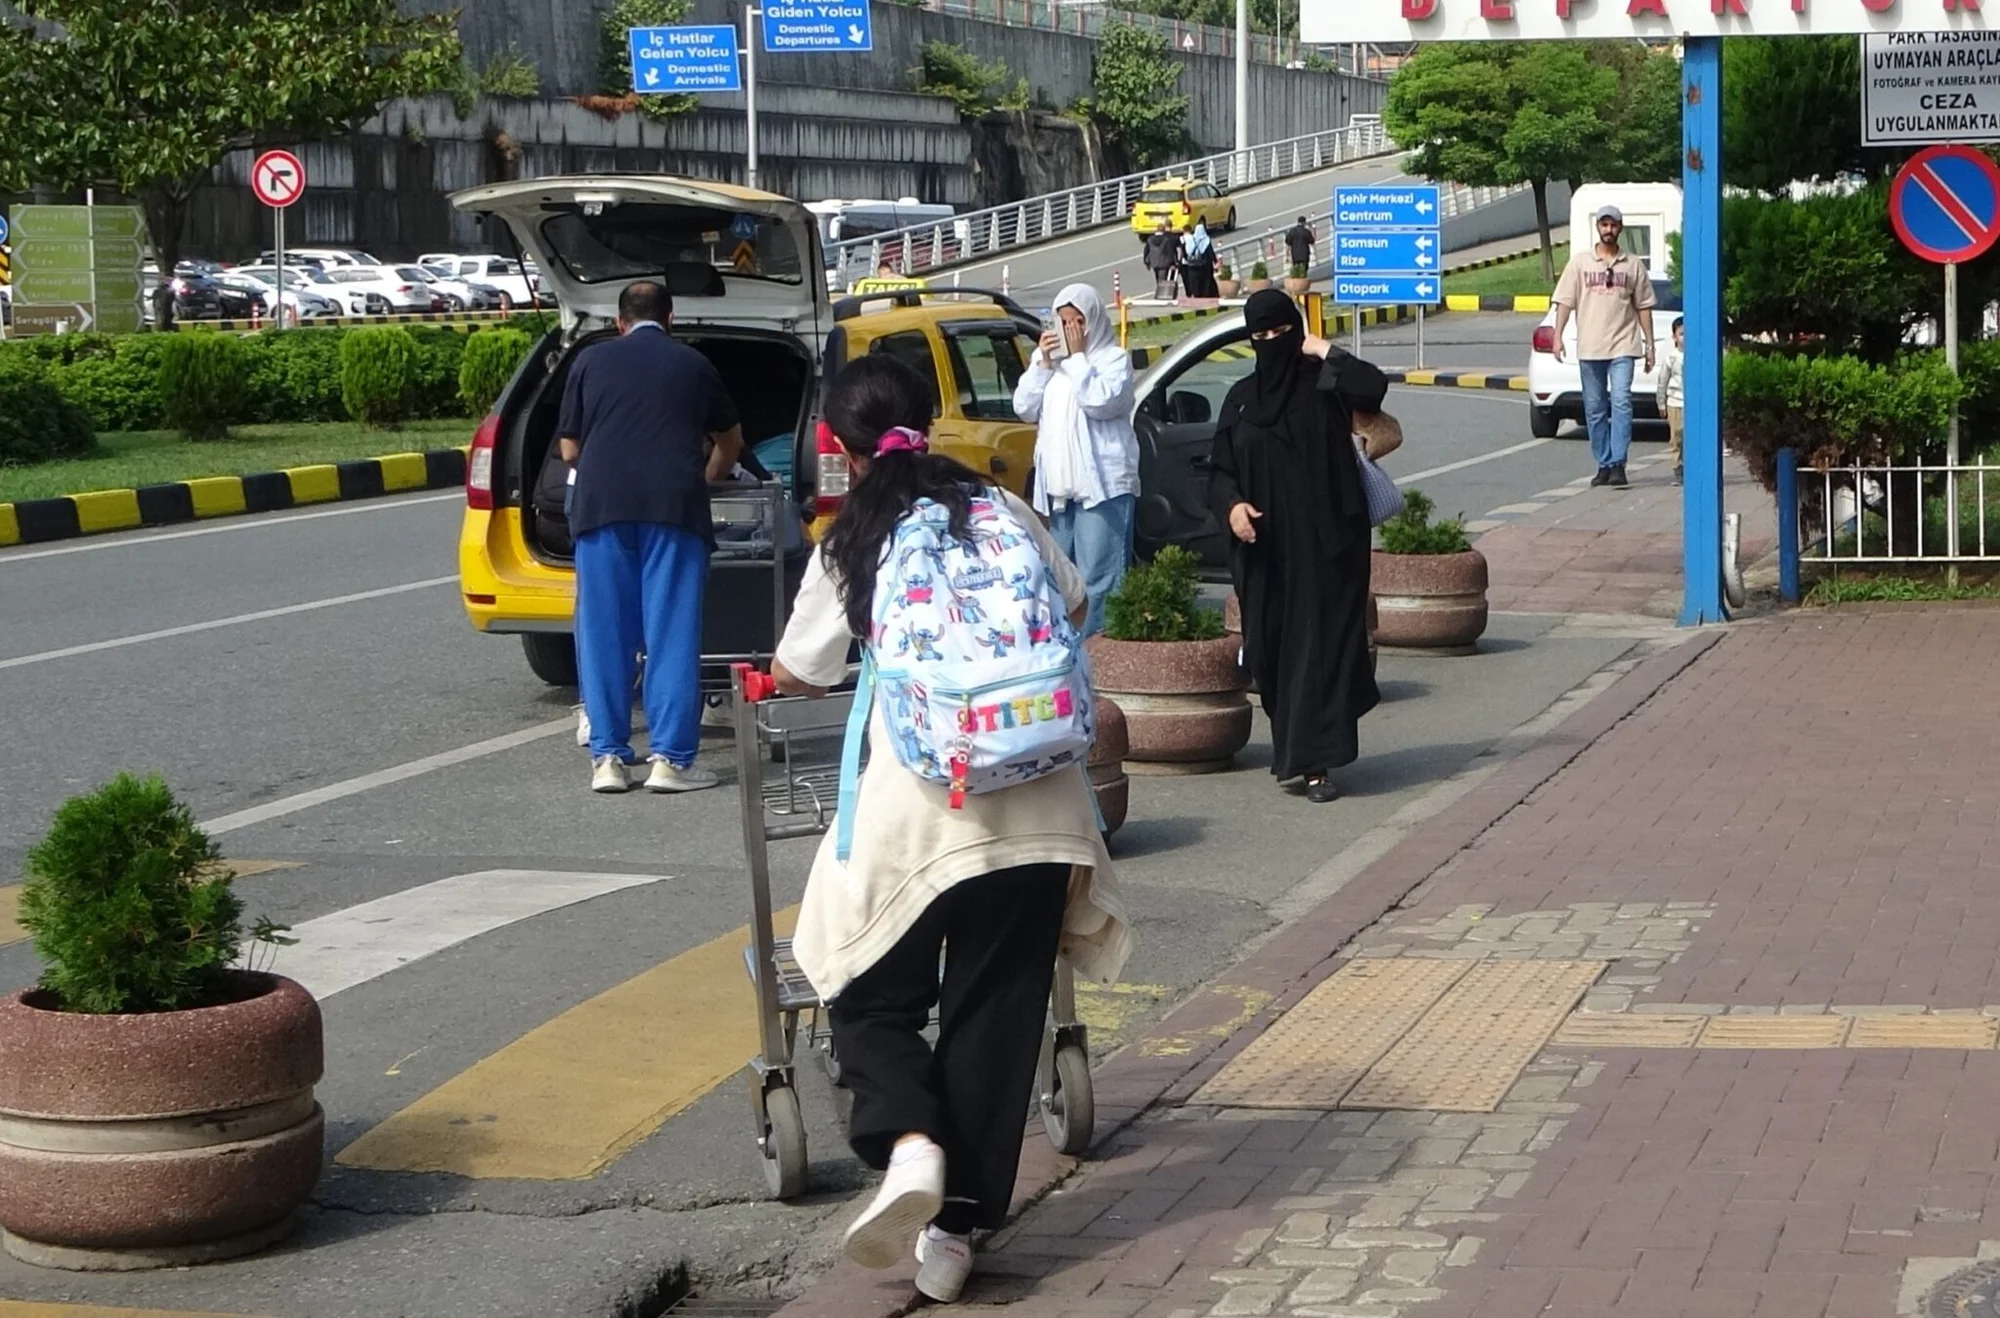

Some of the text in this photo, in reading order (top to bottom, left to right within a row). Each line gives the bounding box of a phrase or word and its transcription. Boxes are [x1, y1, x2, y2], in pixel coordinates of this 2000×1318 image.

[768, 6, 862, 18] Giden Yolcu
[779, 24, 835, 33] Domestic
[650, 31, 715, 47] İç Hatlar
[775, 36, 841, 46] Departures
[640, 47, 729, 59] Gelen Yolcu
[1874, 50, 1942, 69] UYMAYAN
[668, 64, 731, 74] Domestic
[674, 75, 726, 85] Arrivals
[1874, 75, 1922, 88] FOTOĞRAF
[1925, 78, 1935, 87] ve
[1938, 76, 1976, 87] KAMERA
[1920, 93, 1977, 110] CEZA
[1876, 113, 2000, 132] UYGULANMAKTA
[1339, 193, 1414, 205] Şehir Merkezi
[1340, 211, 1393, 221] Centrum
[1340, 238, 1389, 248] Samsun
[1341, 255, 1366, 266] Rize
[1339, 283, 1390, 297] Otopark
